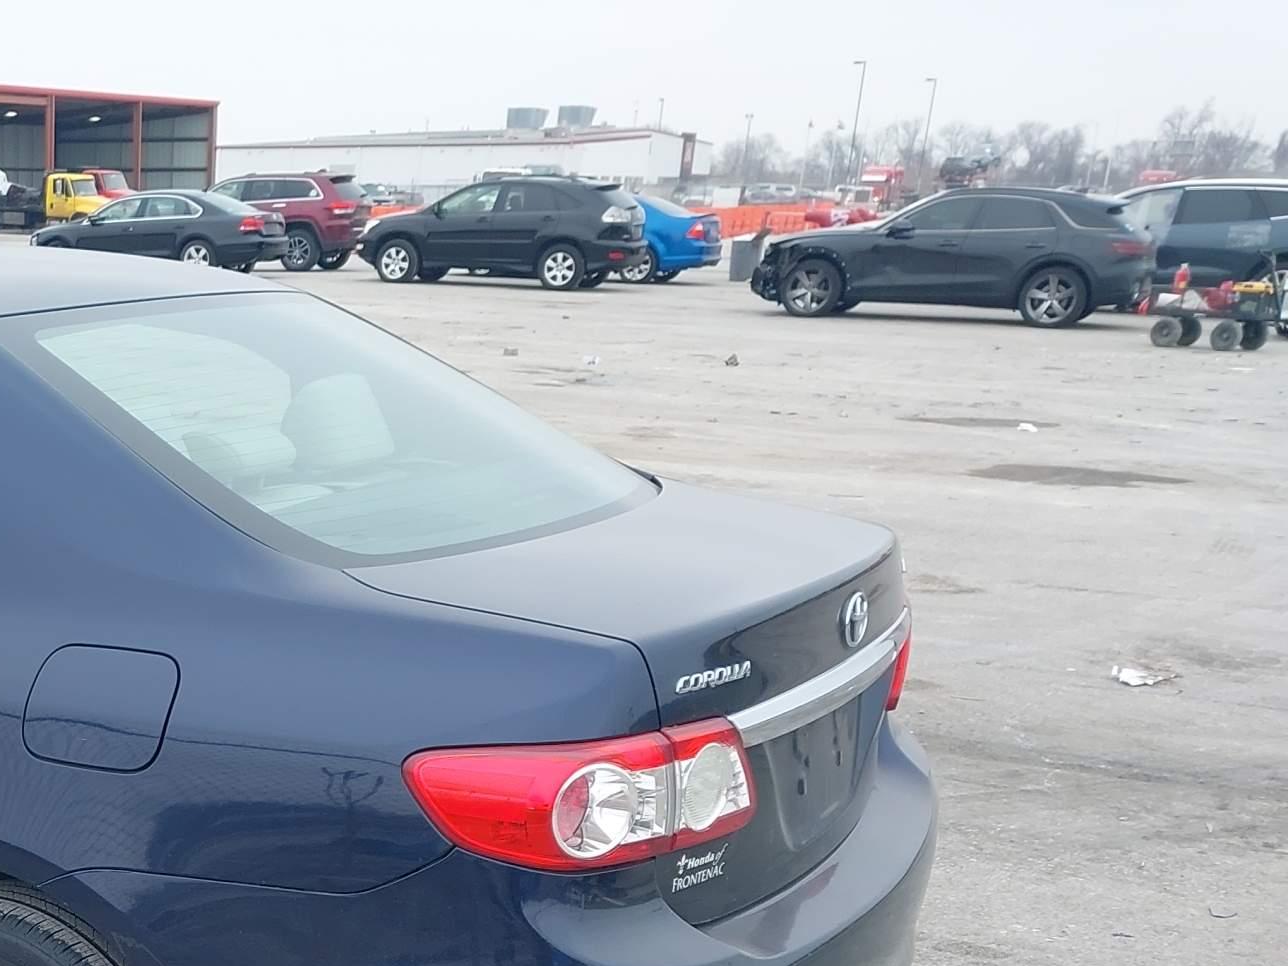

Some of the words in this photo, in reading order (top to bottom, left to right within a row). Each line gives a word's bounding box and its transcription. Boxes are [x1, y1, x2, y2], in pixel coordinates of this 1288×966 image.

[675, 660, 752, 694] COROLLA
[686, 851, 715, 870] Honda
[672, 861, 726, 893] FRONTENAC
